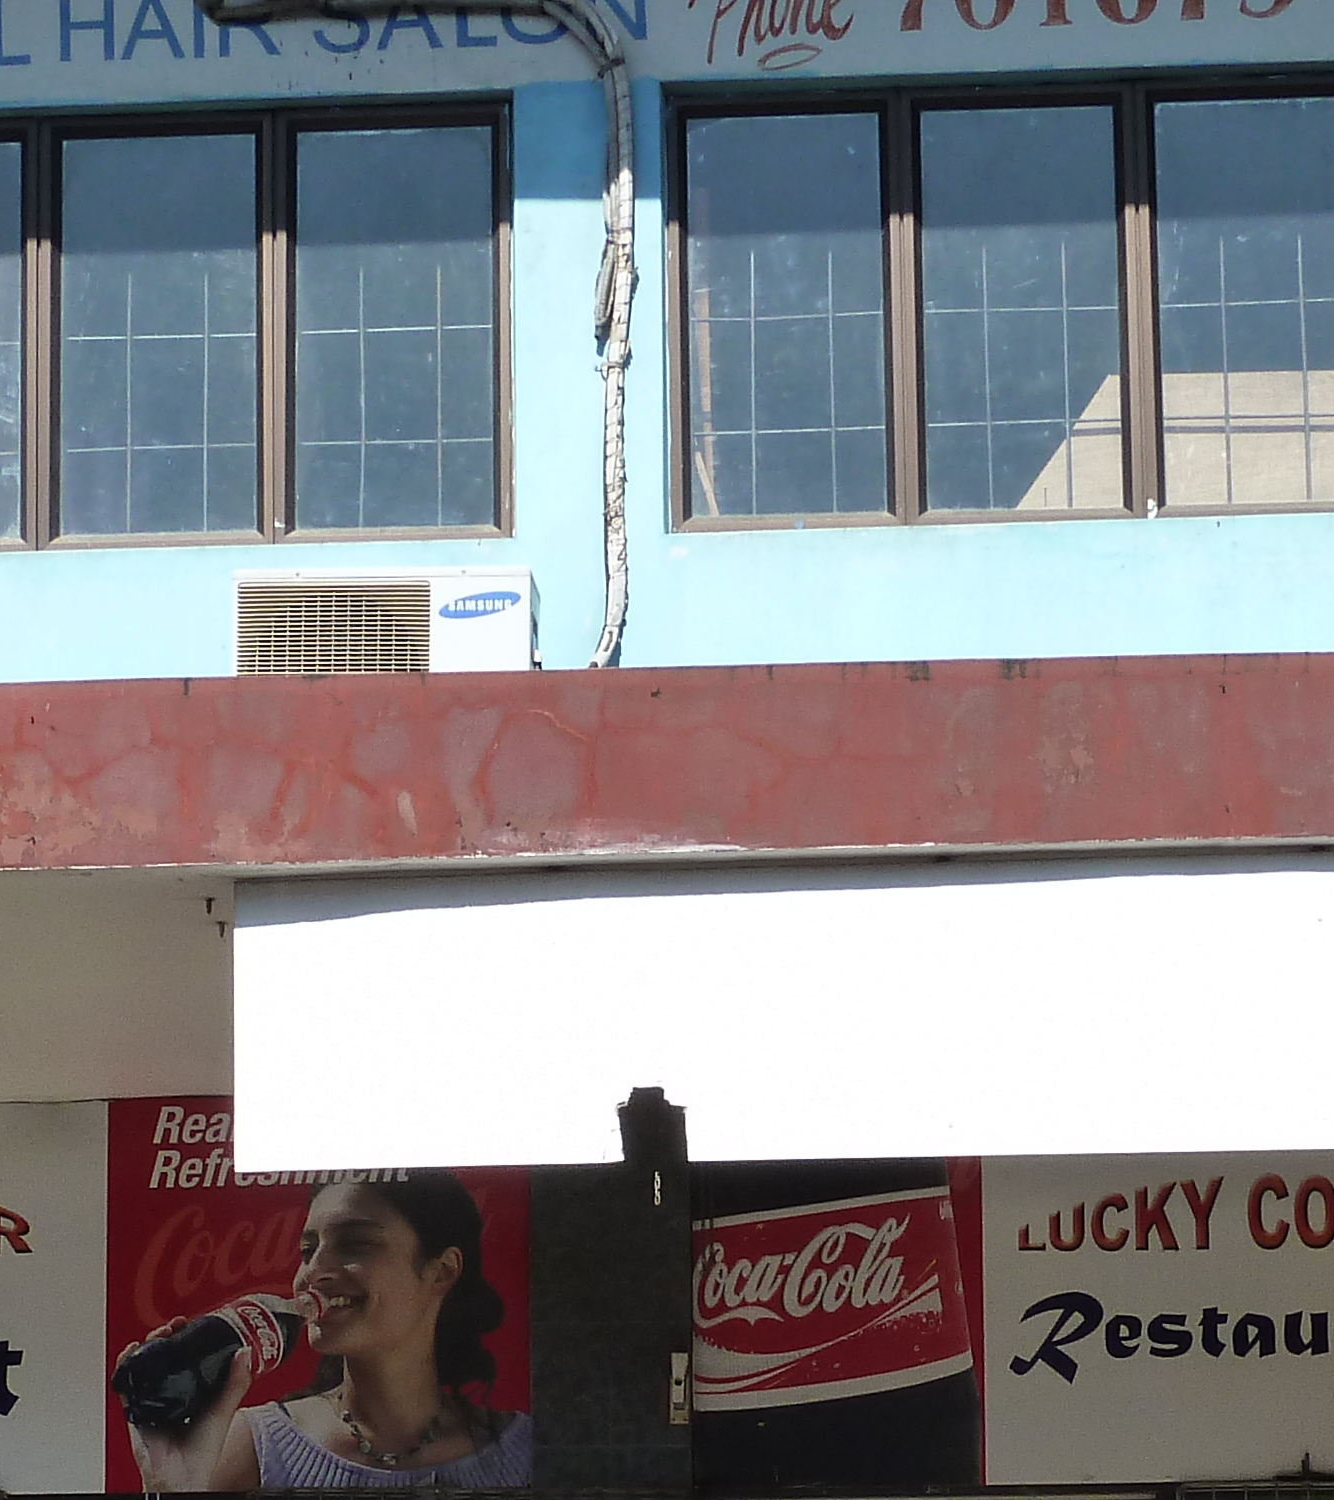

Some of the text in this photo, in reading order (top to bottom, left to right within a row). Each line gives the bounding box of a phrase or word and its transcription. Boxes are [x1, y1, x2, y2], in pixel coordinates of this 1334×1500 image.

[59, 0, 281, 62] HAIR
[447, 598, 513, 612] SAMSUNG
[152, 1105, 235, 1145] Rea
[1018, 1175, 1224, 1252] LUCKY
[693, 1212, 911, 1329] Coca-Cola
